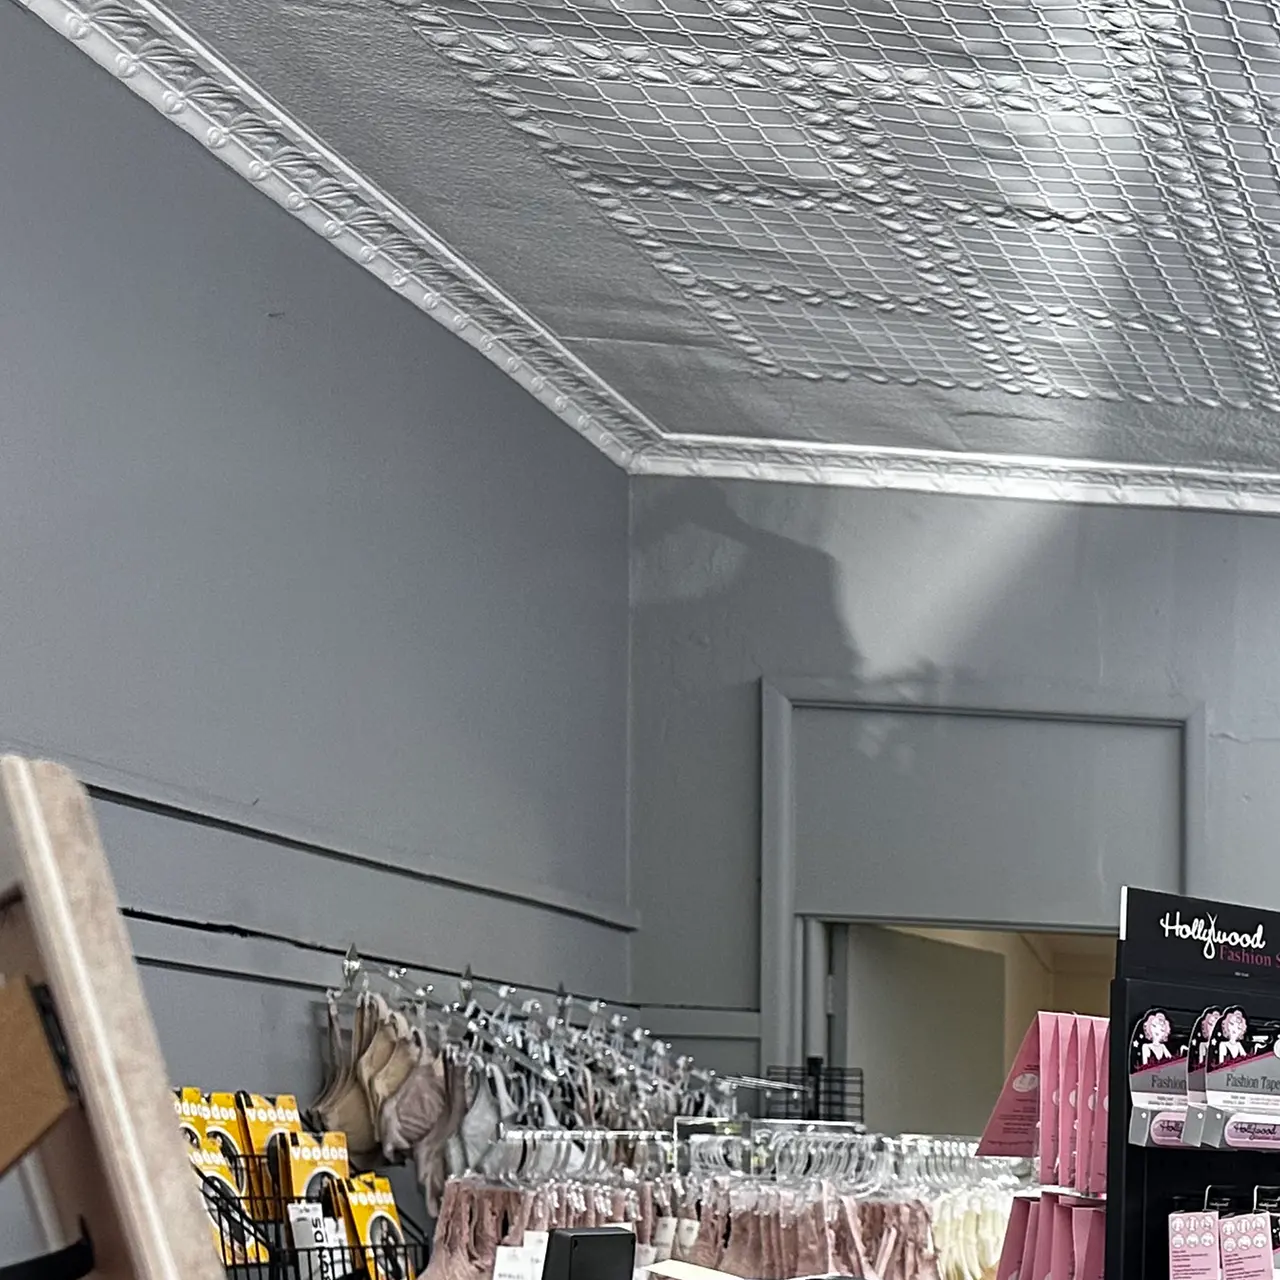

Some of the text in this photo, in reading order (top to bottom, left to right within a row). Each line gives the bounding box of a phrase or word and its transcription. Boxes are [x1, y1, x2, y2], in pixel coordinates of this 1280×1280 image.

[1159, 911, 1266, 960] Hollywood
[1219, 944, 1272, 967] Fashion
[1151, 1074, 1187, 1089] Fashion
[1226, 1074, 1280, 1091] Fashion Tape
